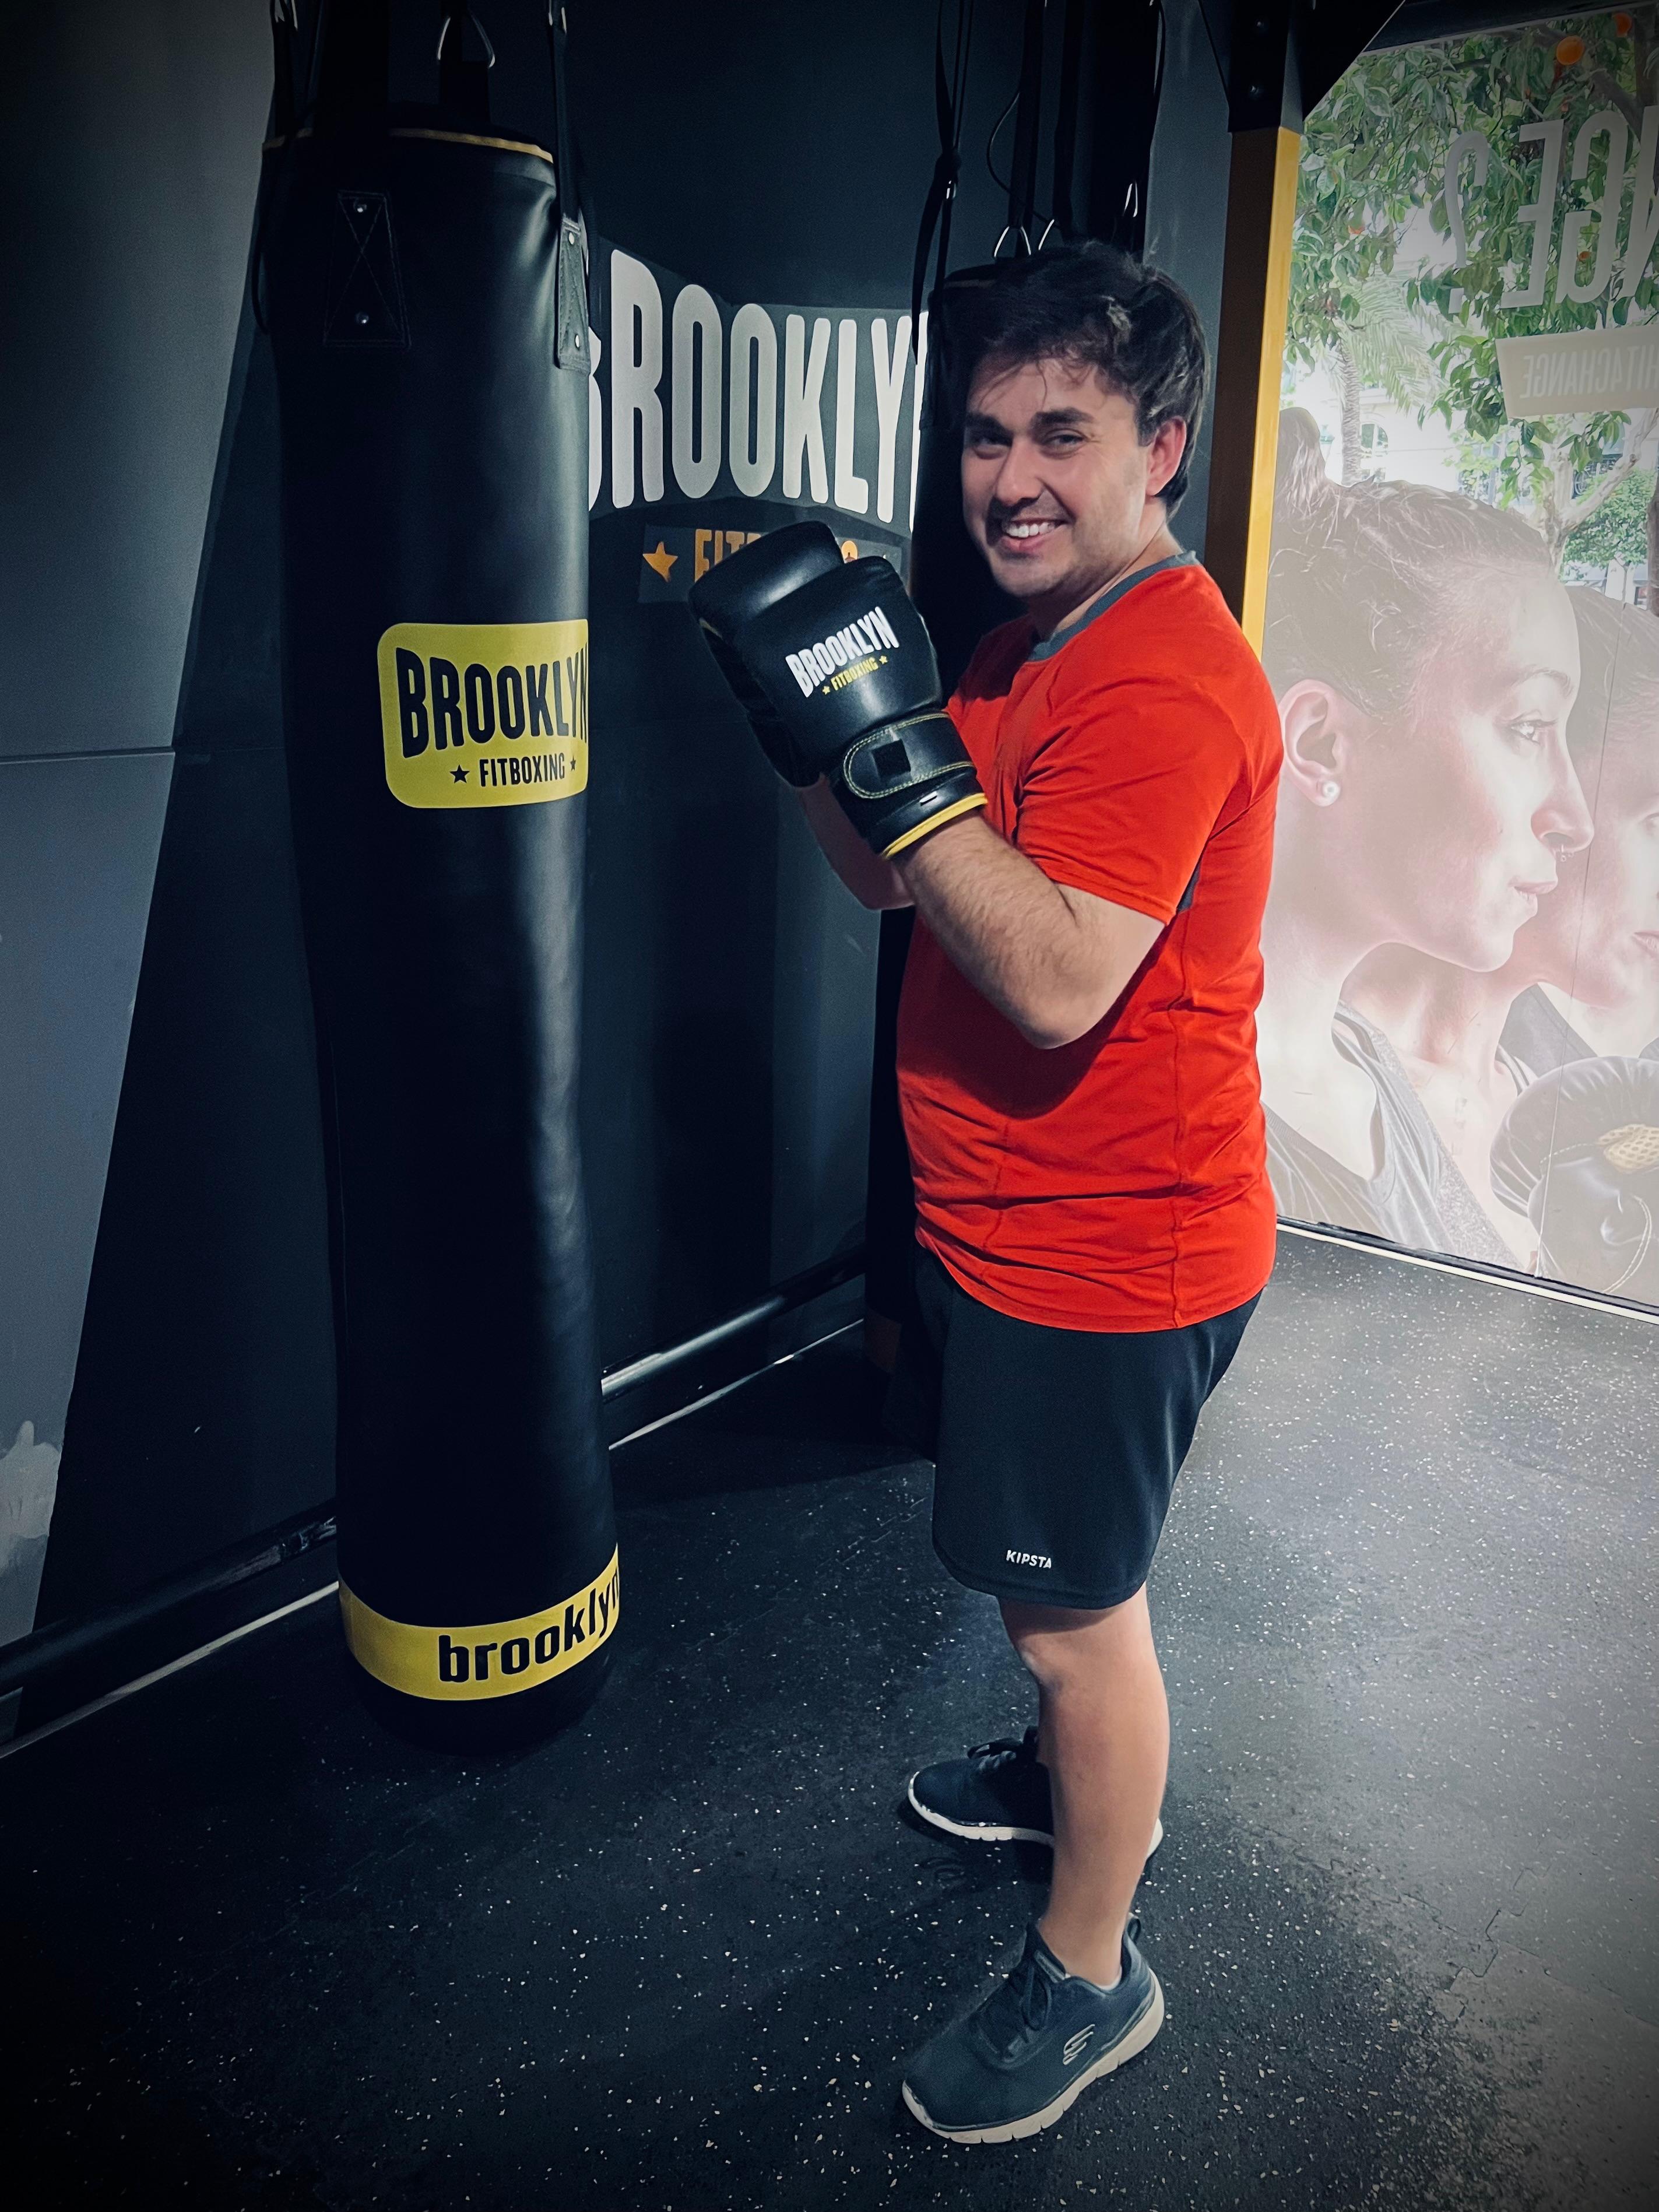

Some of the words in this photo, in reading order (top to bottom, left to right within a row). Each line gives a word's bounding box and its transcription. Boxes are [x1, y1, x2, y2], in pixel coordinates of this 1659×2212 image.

[589, 249, 929, 533] ROOKLY
[785, 606, 899, 698] BROOKLYN
[830, 656, 879, 691] FITBOXING
[396, 642, 587, 759] BROOKLYN
[479, 753, 565, 787] FITBOXING
[1006, 1550, 1052, 1568] KIPSTA
[438, 1565, 618, 1683] brooklyn
